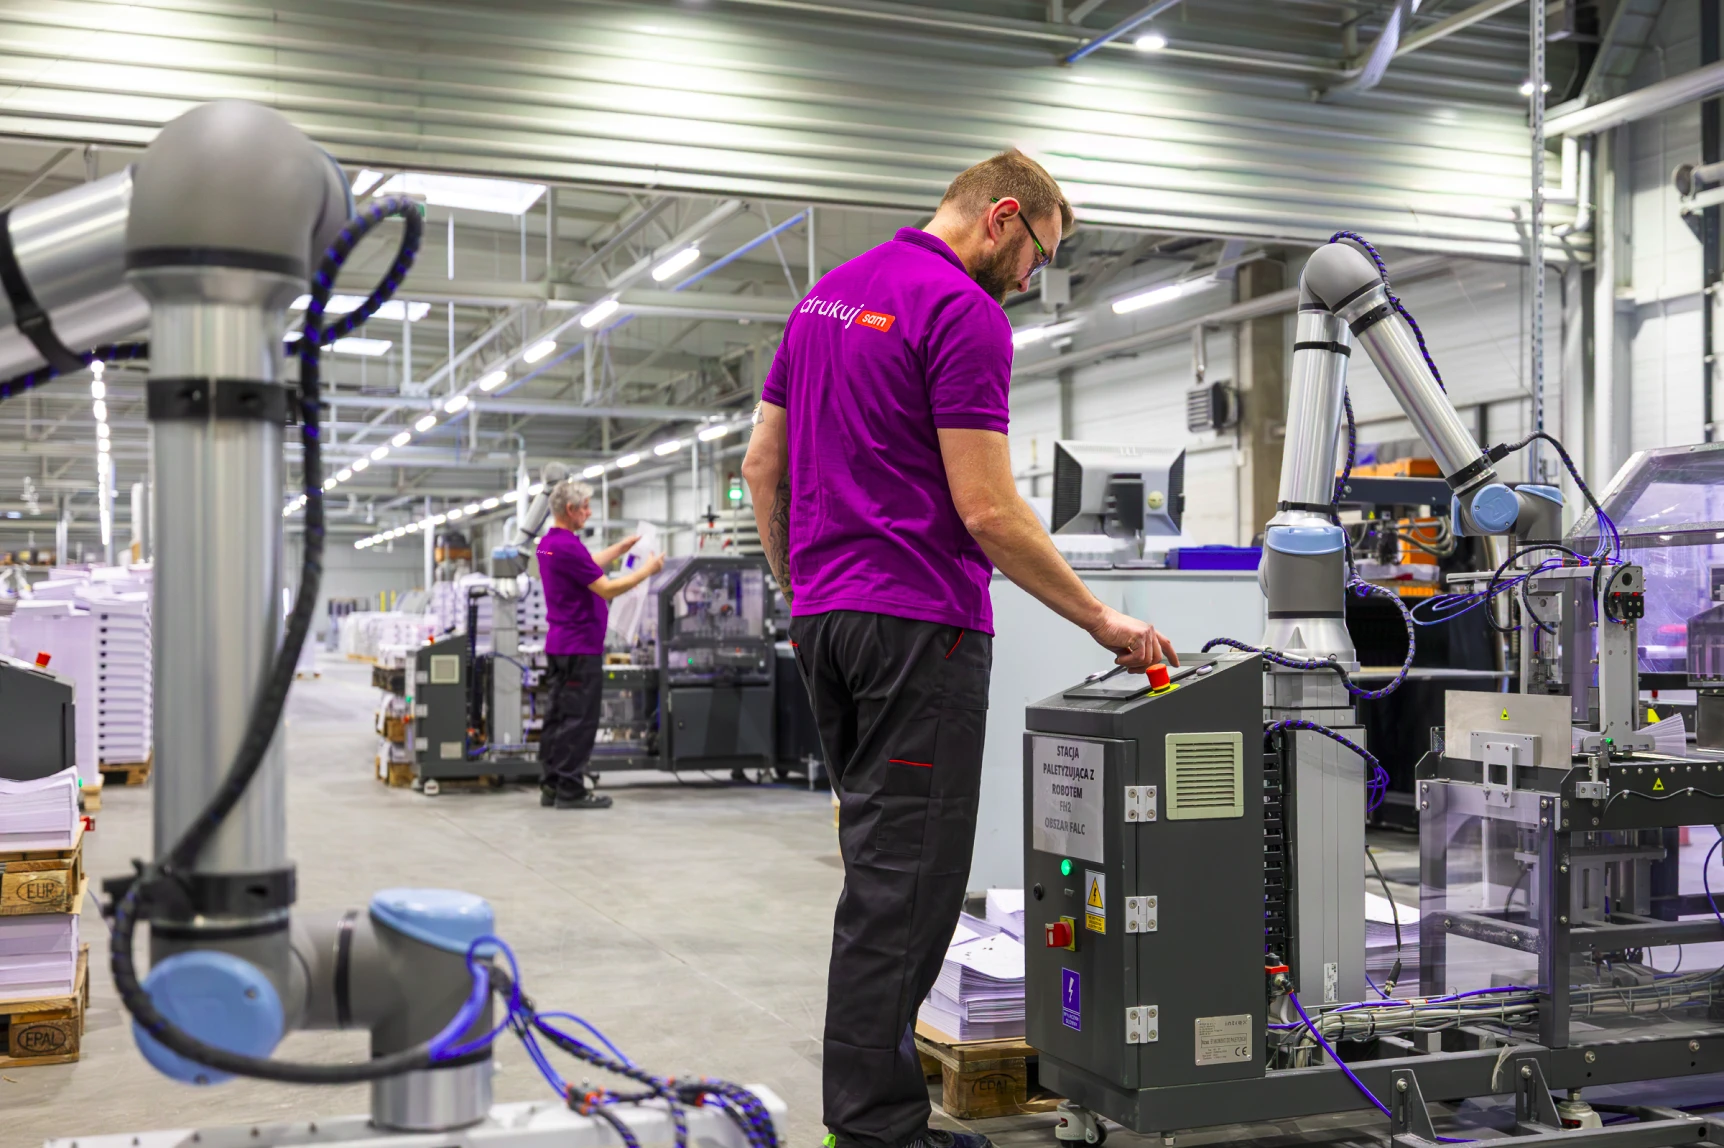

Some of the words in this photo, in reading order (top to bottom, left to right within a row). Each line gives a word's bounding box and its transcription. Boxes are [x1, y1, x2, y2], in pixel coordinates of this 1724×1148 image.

[799, 295, 865, 329] drukuj
[862, 313, 887, 327] sam
[1057, 745, 1080, 761] STACJA
[1043, 763, 1089, 781] PALETYZUJĄCA
[1090, 769, 1095, 780] Z
[1052, 783, 1083, 799] ROBOTEM
[1044, 817, 1069, 831] OBSZAR
[1069, 824, 1086, 835] FALC
[26, 883, 55, 899] EUR
[25, 1031, 58, 1047] EPAL
